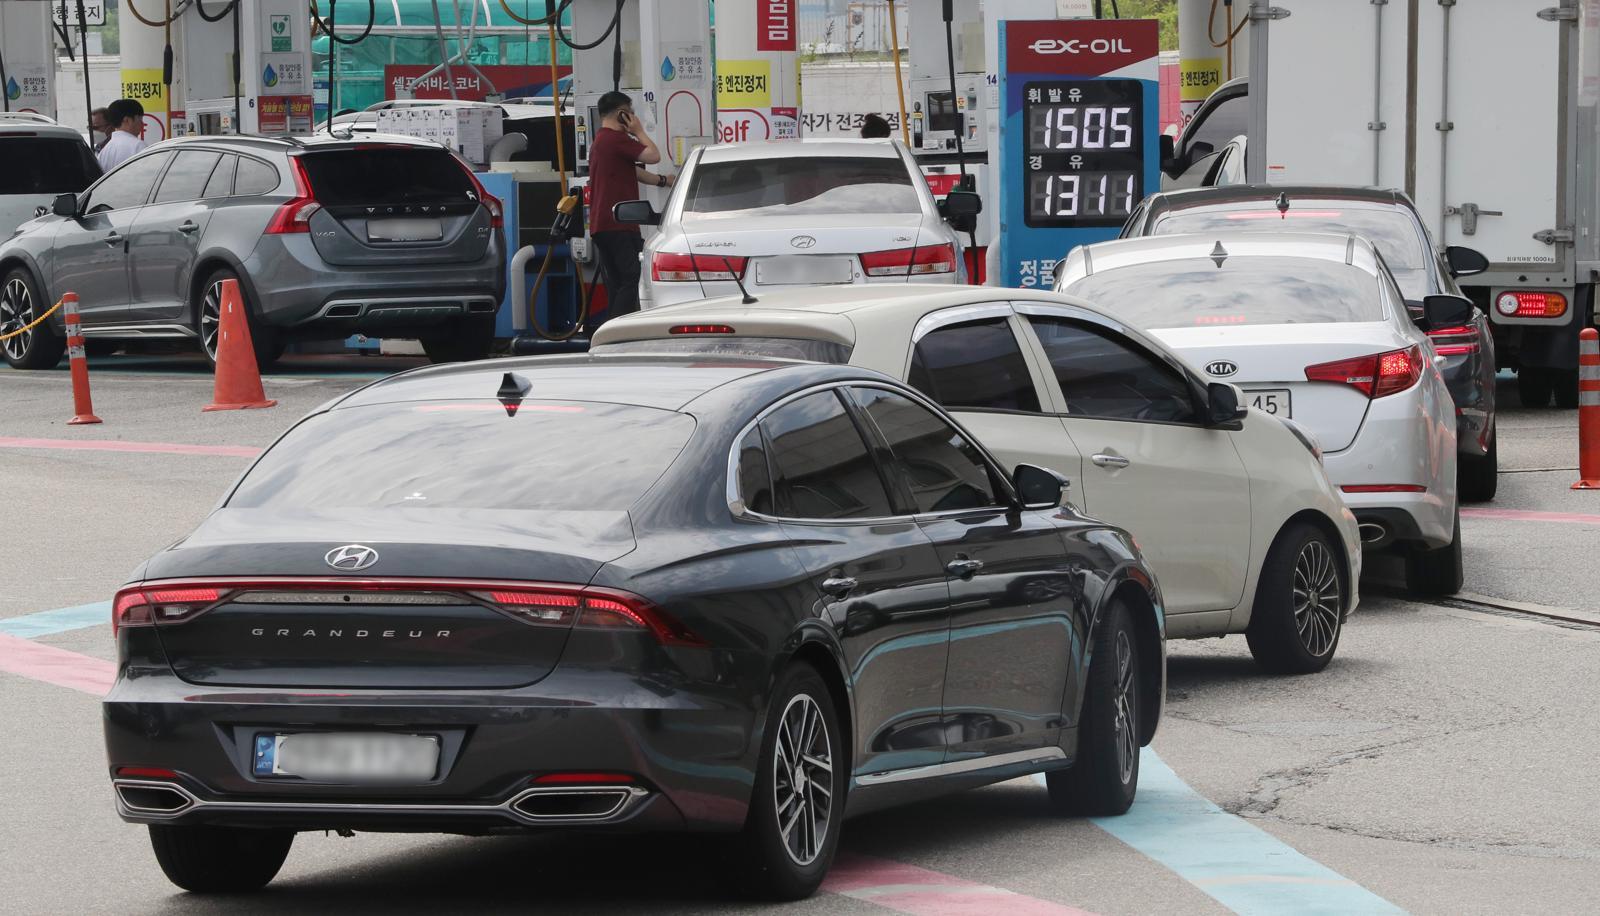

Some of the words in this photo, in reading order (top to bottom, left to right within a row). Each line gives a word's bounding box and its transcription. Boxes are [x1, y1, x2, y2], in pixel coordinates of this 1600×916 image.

[725, 74, 767, 93] 엔진정지
[986, 74, 997, 85] 14
[1185, 69, 1219, 86] 엔진정지
[126, 81, 162, 99] 엔진정지
[643, 91, 654, 101] 10
[248, 98, 255, 108] 6
[802, 113, 832, 132] 자가
[835, 112, 882, 131] 전조
[1043, 106, 1133, 149] 1505
[1043, 174, 1135, 217] 1311
[1019, 259, 1057, 287] 정품
[1210, 363, 1234, 375] KIA
[251, 627, 450, 639] GRANDEUR
